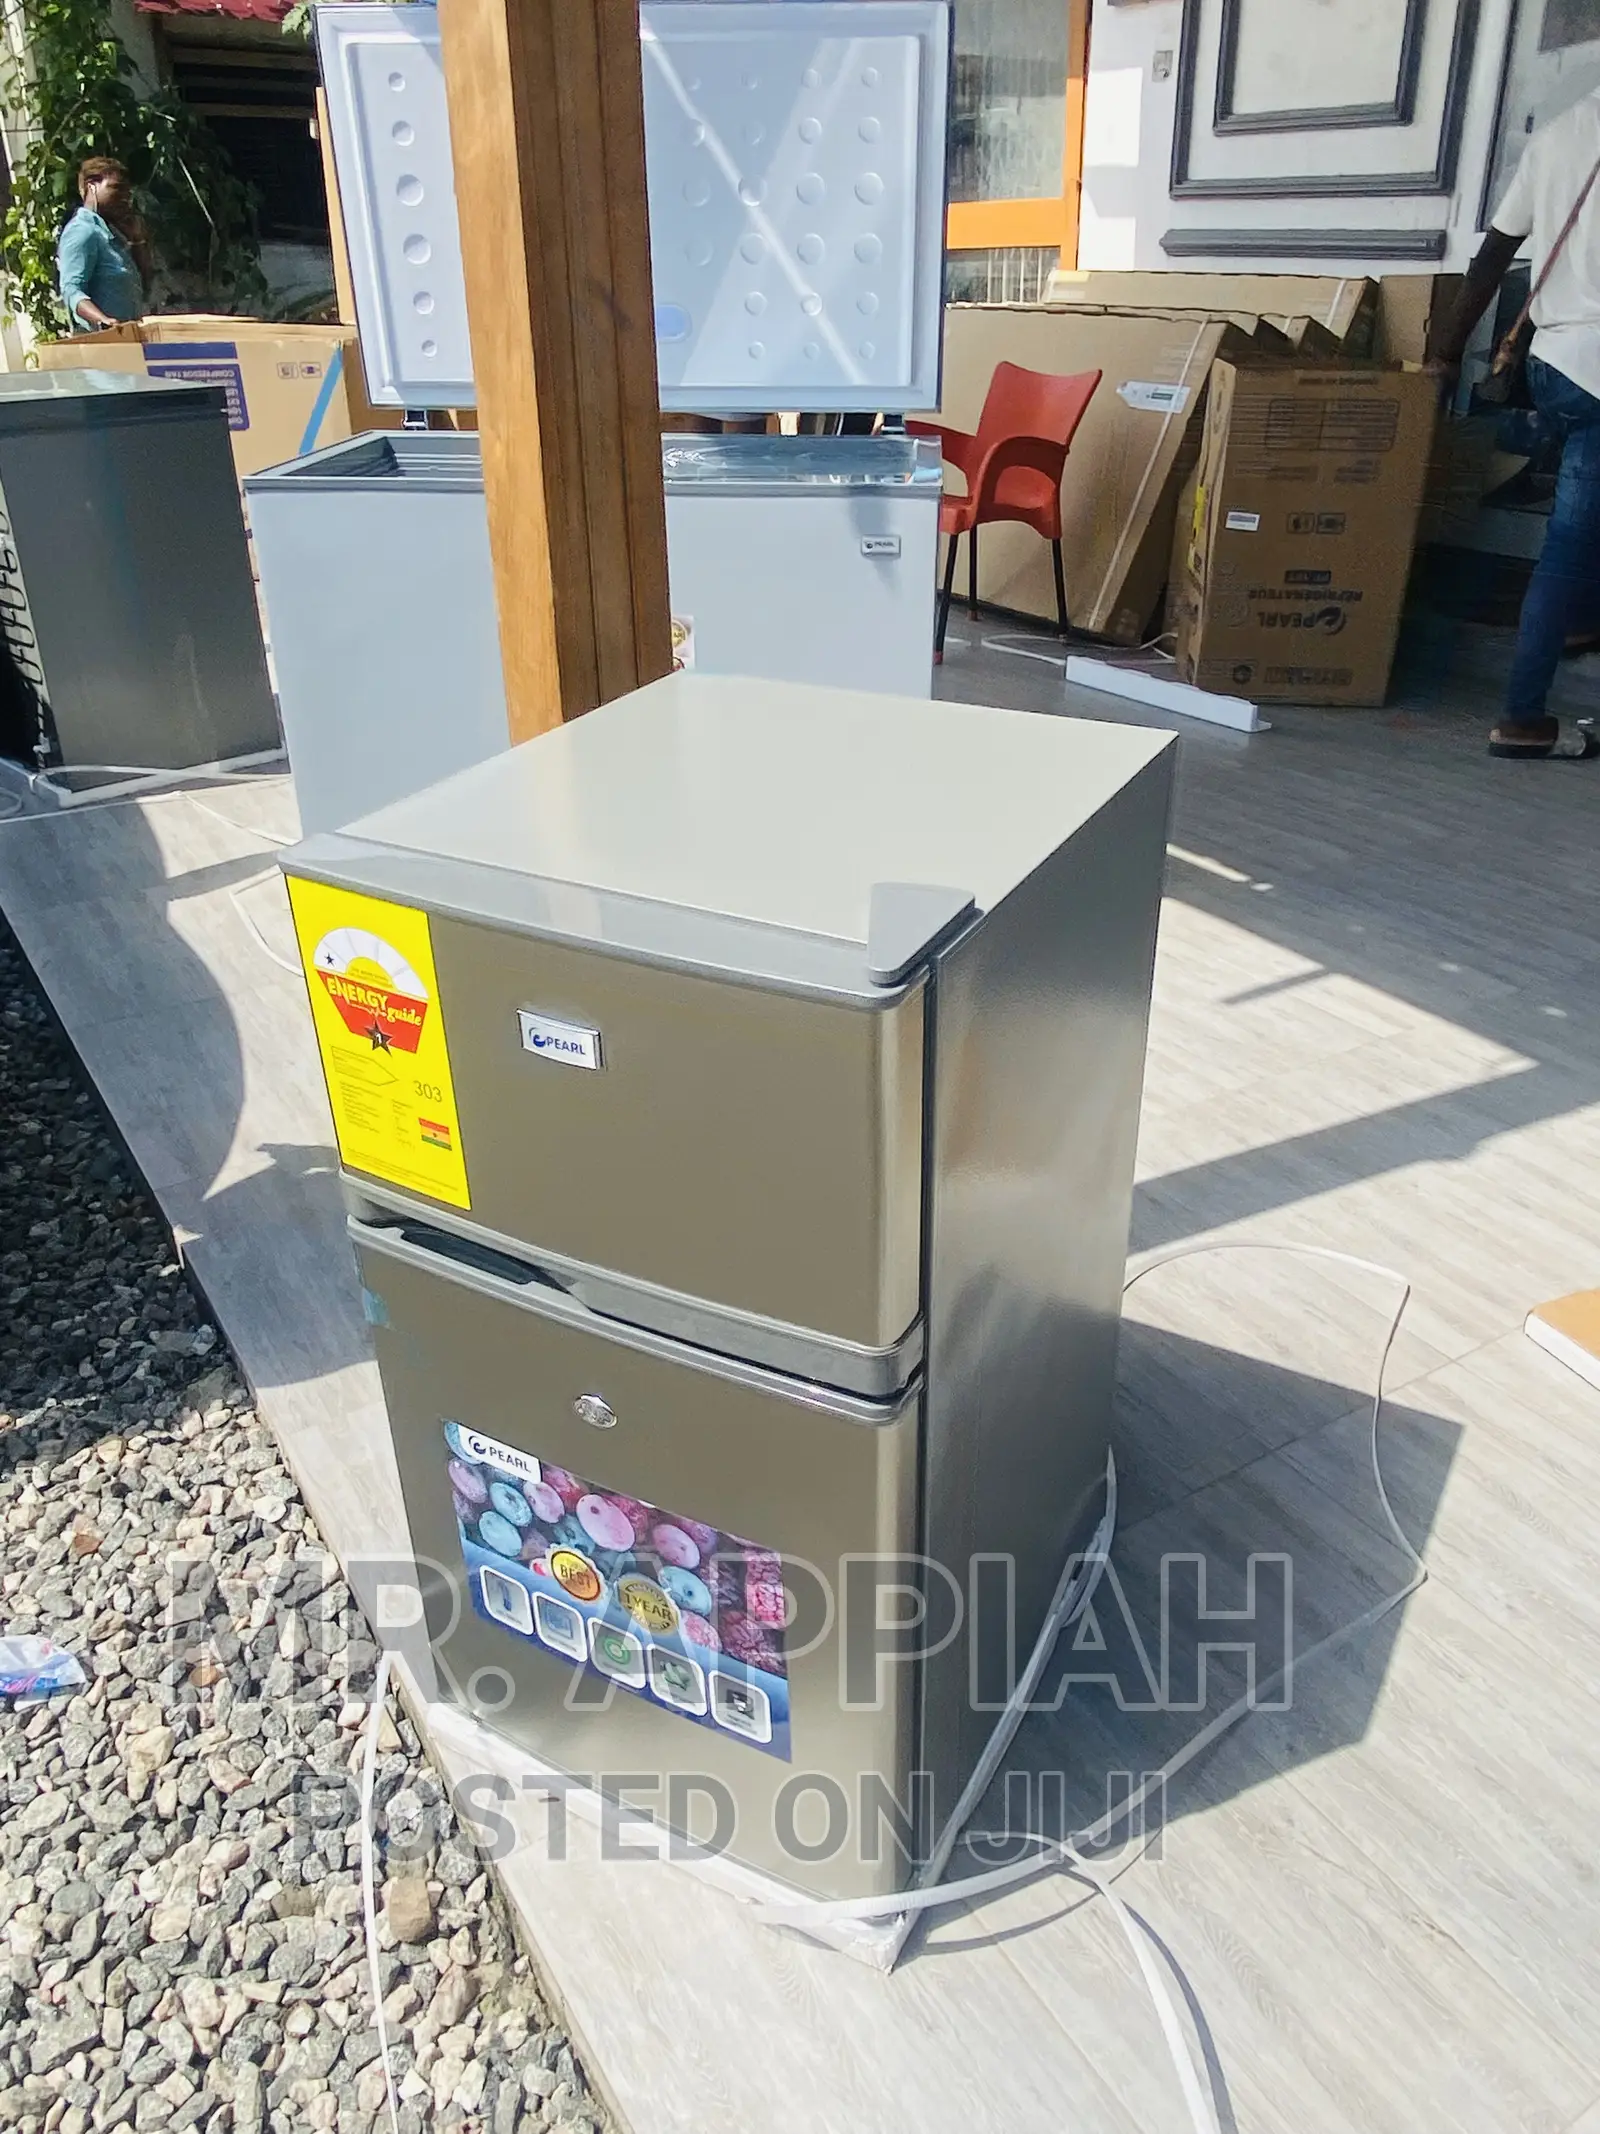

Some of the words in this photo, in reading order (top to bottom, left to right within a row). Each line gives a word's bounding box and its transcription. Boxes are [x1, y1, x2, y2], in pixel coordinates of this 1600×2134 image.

[1257, 610, 1319, 629] PEARL
[326, 976, 389, 1012] ENERGY
[386, 1007, 422, 1027] guide
[546, 1036, 587, 1056] PEARL
[412, 1079, 443, 1103] 303
[488, 1445, 532, 1474] PEARL
[560, 1563, 592, 1589] BEST
[633, 1596, 675, 1623] YEAR
